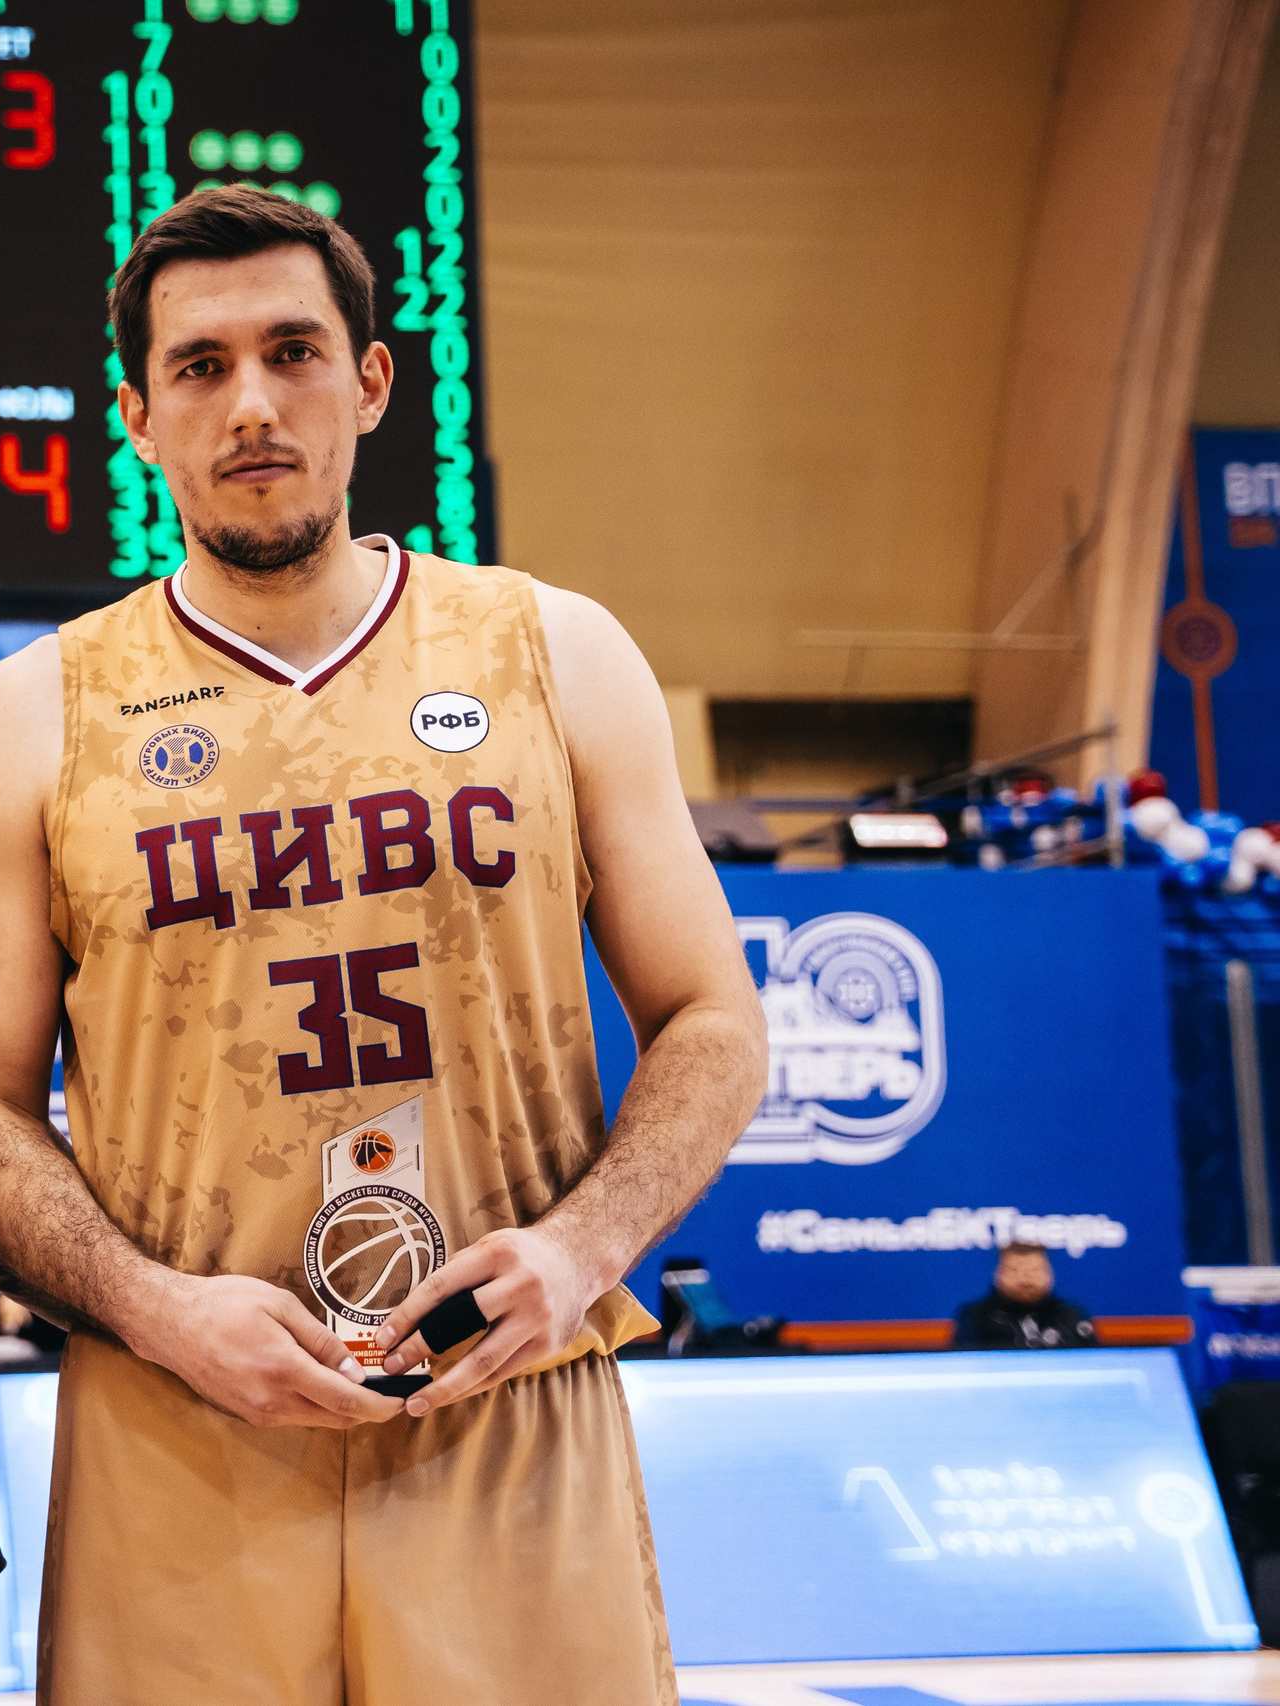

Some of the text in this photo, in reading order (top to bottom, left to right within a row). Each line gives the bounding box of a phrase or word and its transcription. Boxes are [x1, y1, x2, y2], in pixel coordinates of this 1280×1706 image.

[132, 22, 173, 73] 7
[421, 32, 459, 84] 0
[101, 70, 174, 125] 10
[422, 82, 461, 134] 0
[102, 123, 167, 173] 11
[423, 131, 463, 184] 2
[425, 182, 464, 234] 0
[394, 226, 467, 283] 12
[392, 277, 468, 331] 22
[430, 329, 469, 381] 0
[432, 378, 472, 430] 0
[434, 427, 474, 479] 5
[108, 520, 187, 577] 35
[421, 711, 480, 731] РФБ
[143, 727, 216, 786] ЦЕНТР ИГРОВЫХ ВИДОВ СПОРТА
[135, 786, 516, 931] ЦИВС
[267, 941, 434, 1096] 35
[325, 1203, 337, 1216] ПО
[336, 1186, 390, 1206] БАСКЕТБОЛУ
[391, 1188, 419, 1209] СРЕДИ
[312, 1216, 327, 1235] ЦФО
[417, 1205, 443, 1246] МУЖСКИХ
[307, 1235, 321, 1289] ЧЕМПИОНАТ
[340, 1307, 371, 1324] СЕЗОН
